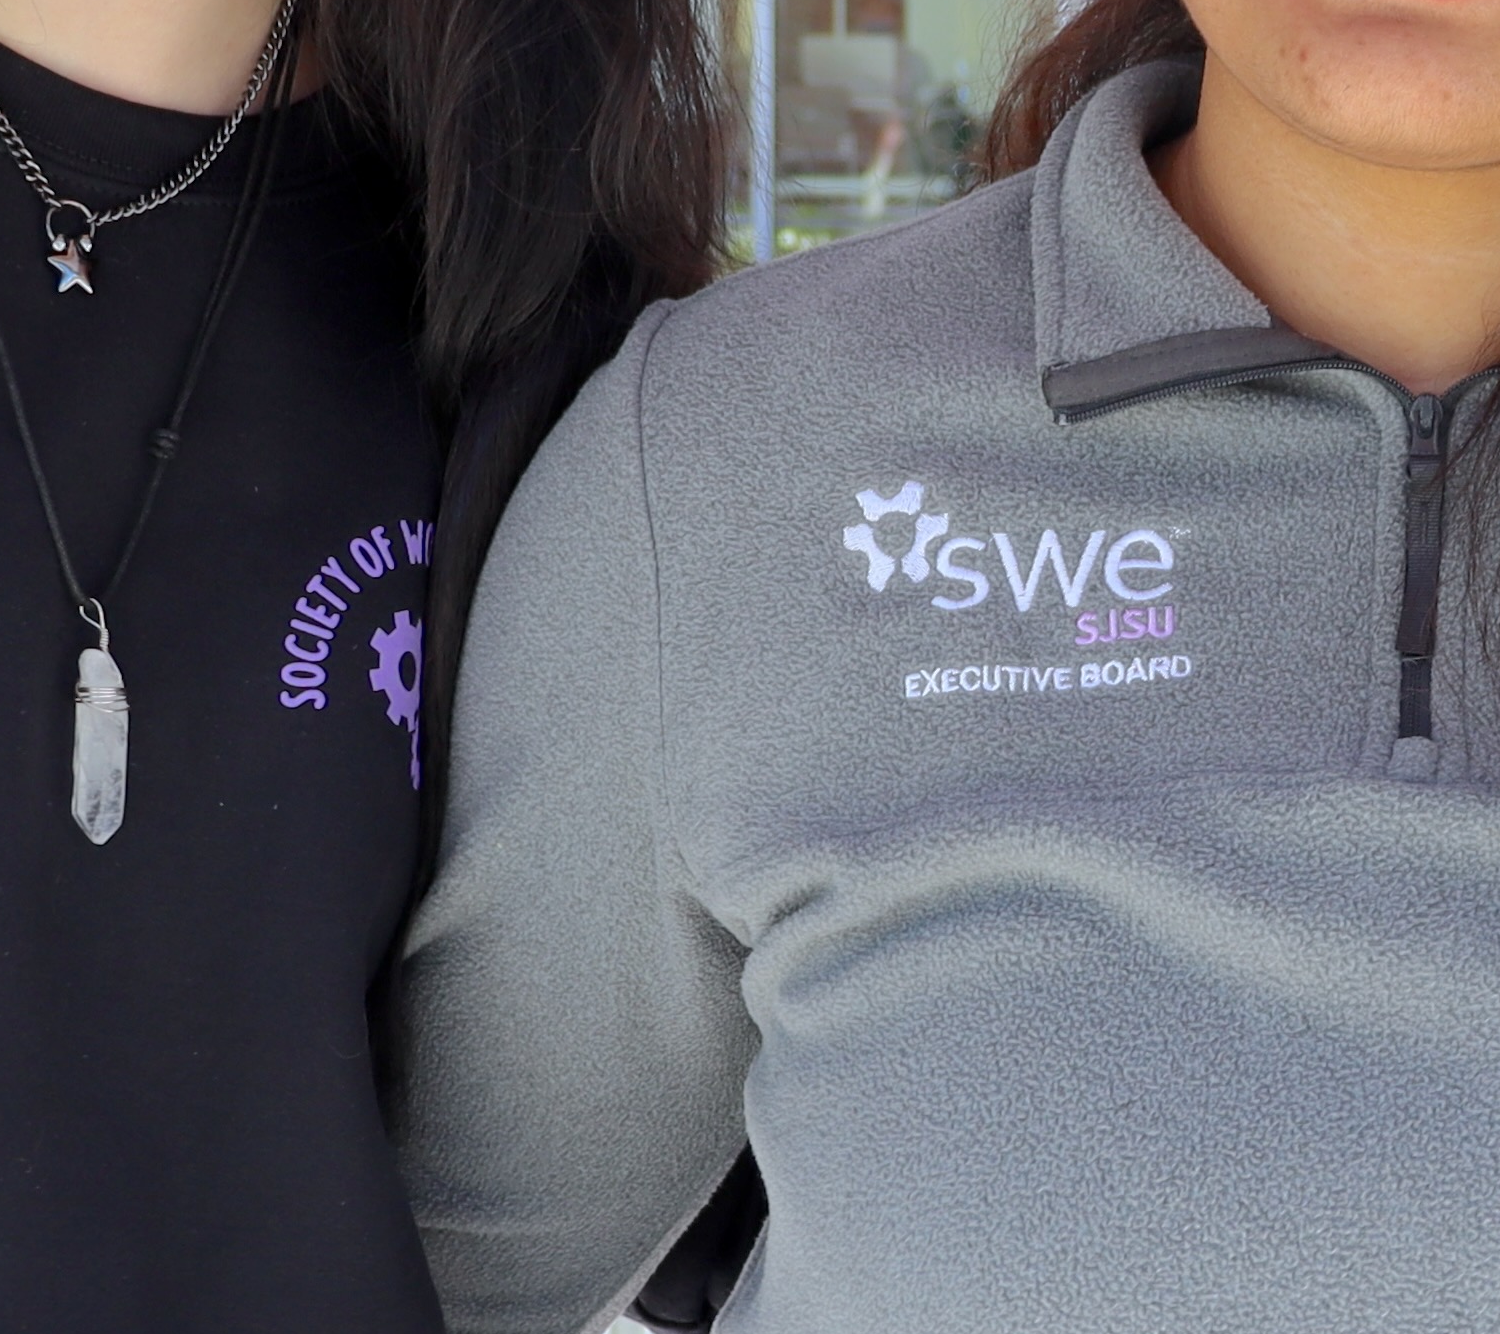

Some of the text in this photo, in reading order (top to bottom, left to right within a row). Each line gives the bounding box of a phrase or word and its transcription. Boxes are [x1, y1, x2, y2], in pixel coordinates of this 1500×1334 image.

[931, 529, 1175, 612] swe
[280, 520, 433, 710] SOCIETY OF W
[1075, 606, 1175, 645] SJSU
[905, 655, 1191, 698] EXECUTIVE BOARD
